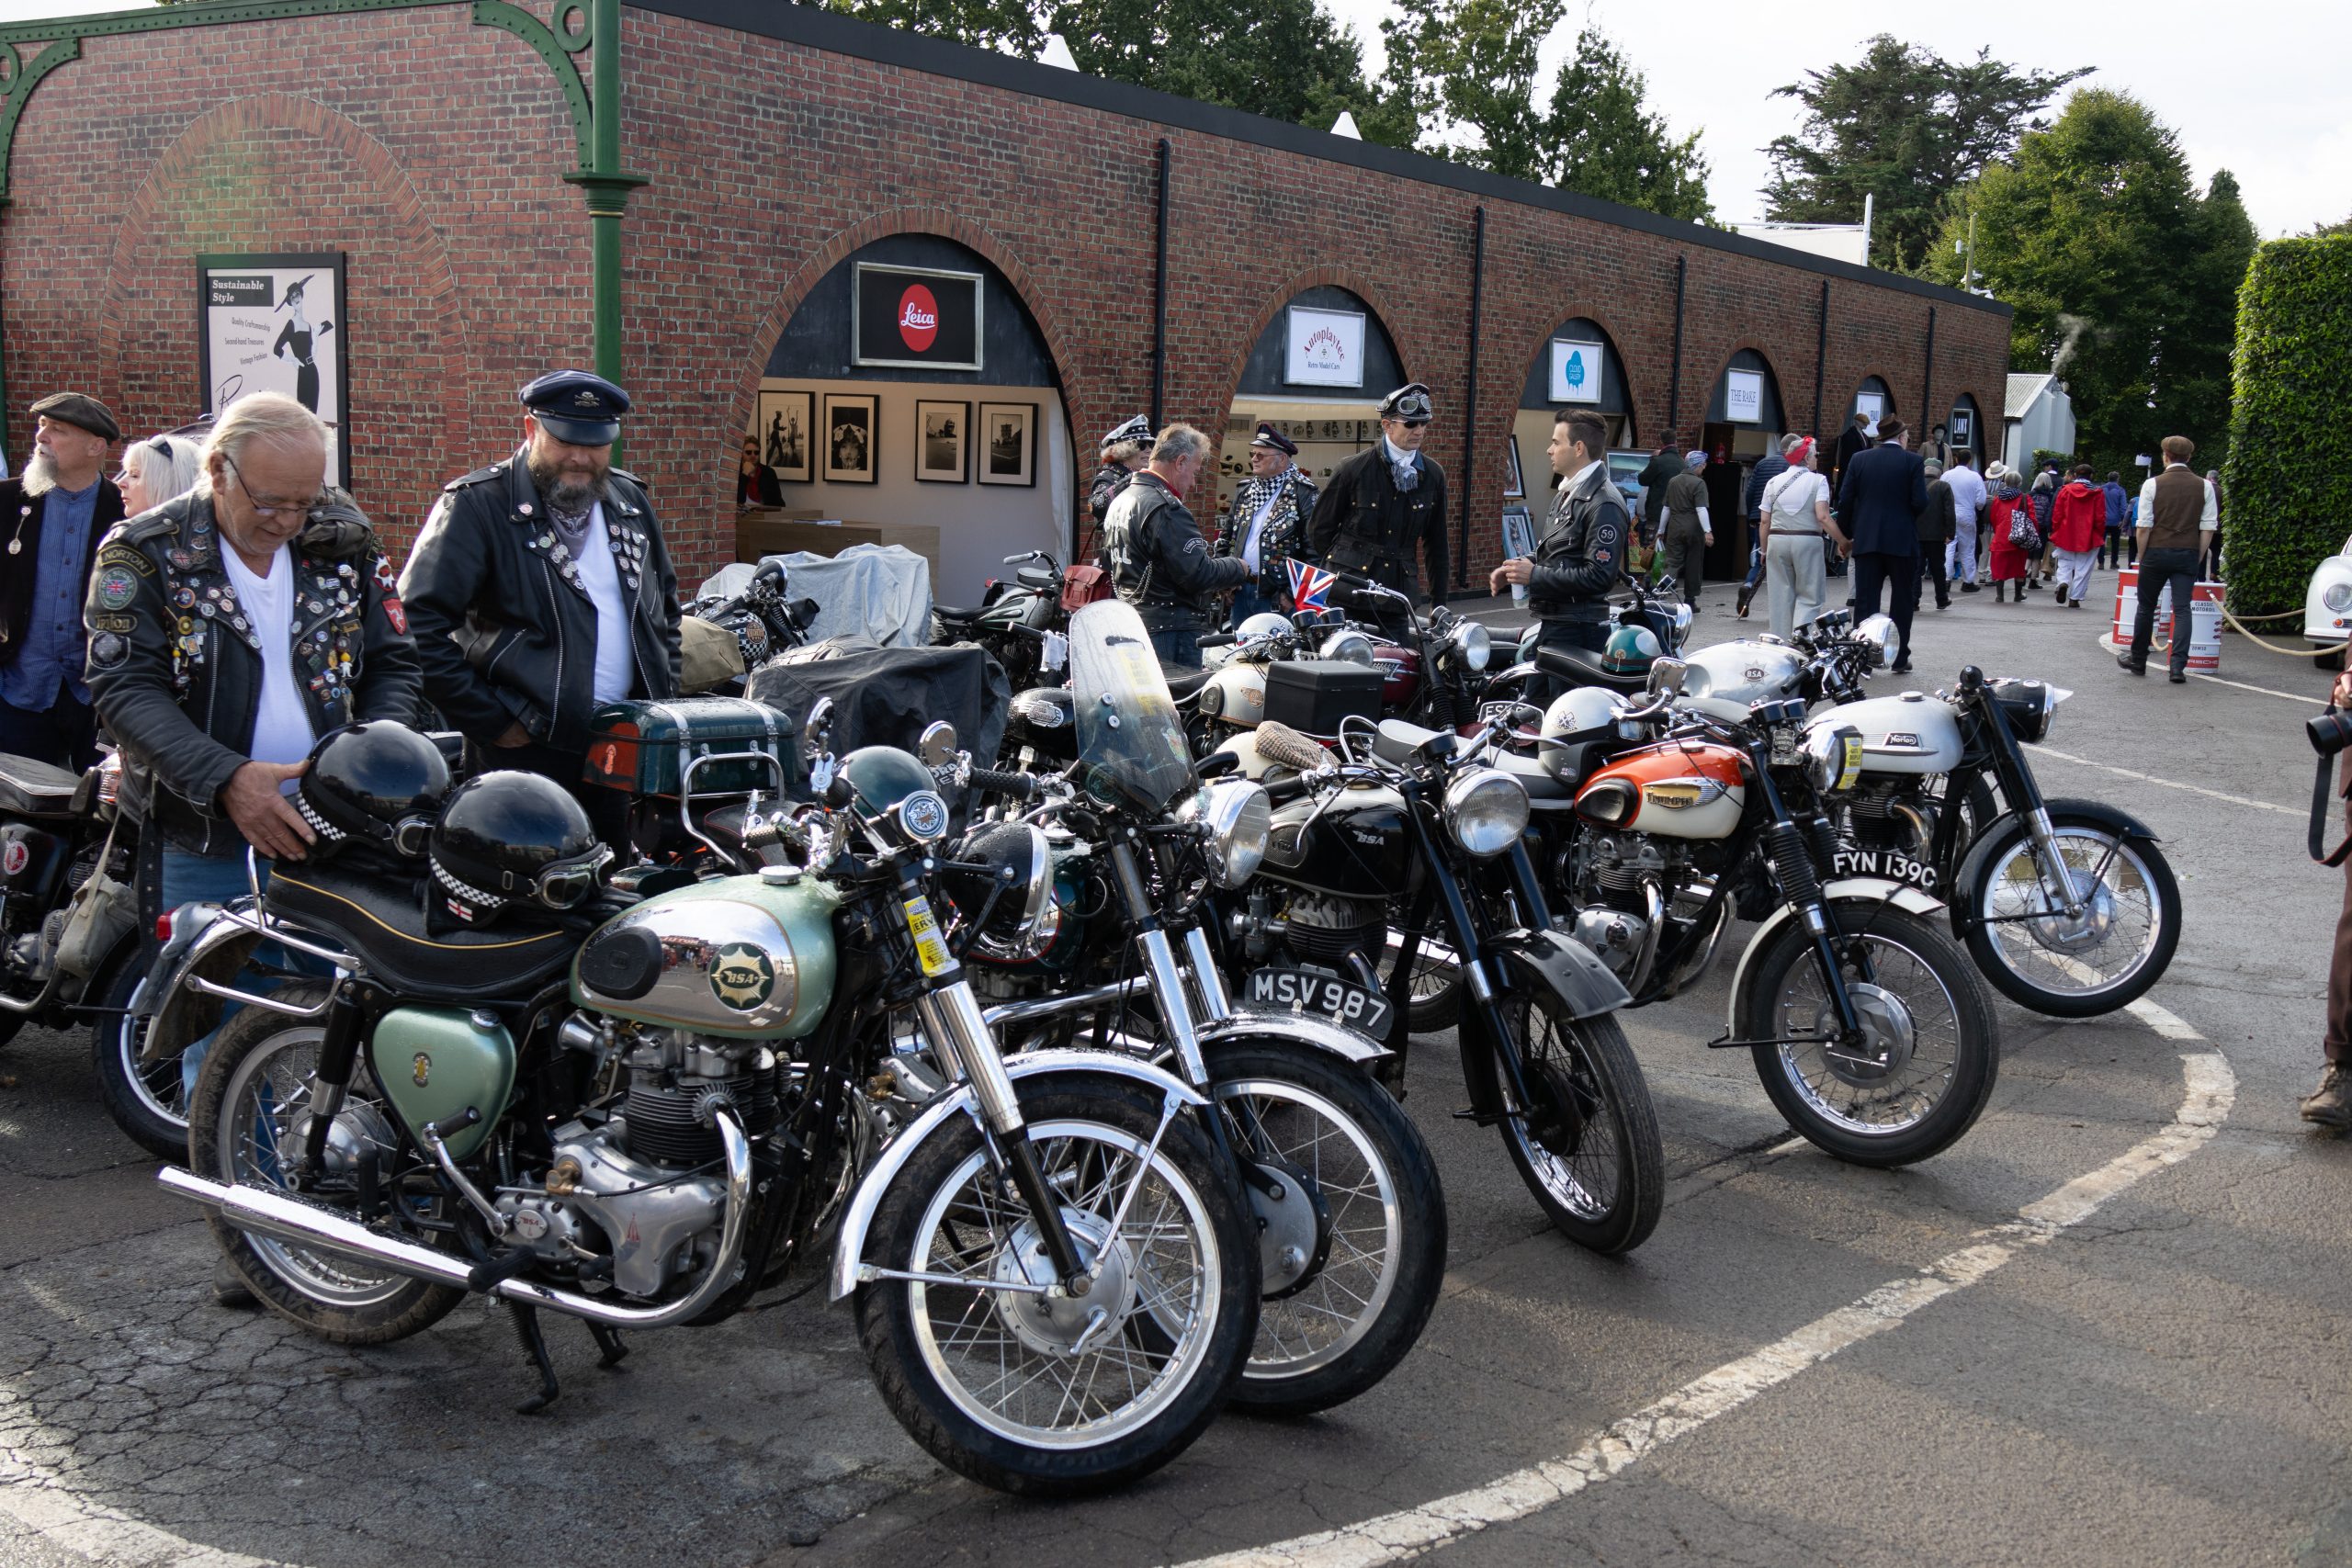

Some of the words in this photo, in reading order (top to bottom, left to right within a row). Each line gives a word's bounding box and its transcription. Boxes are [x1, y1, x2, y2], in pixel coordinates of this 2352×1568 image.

[212, 279, 265, 290] Sustainable
[212, 292, 235, 305] Style
[900, 301, 935, 330] Leica
[232, 316, 244, 328] Quality
[244, 319, 271, 333] Craftsmanship
[224, 337, 247, 345] Second-hand
[247, 337, 265, 346] Treasures
[240, 357, 254, 366] Vintage
[253, 352, 268, 362] Fashion
[1730, 389, 1742, 402] THE
[1742, 389, 1757, 403] RAKE
[1953, 417, 1968, 434] LANX
[1600, 529, 1614, 539] 59
[104, 549, 148, 570] NORTON
[1747, 670, 1762, 678] BSA
[1889, 734, 1917, 745] Norton
[1646, 793, 1694, 806] TRIUMPH
[1351, 829, 1385, 846] BSA
[1832, 851, 1877, 874] FYN
[1884, 854, 1937, 887] 139C
[722, 970, 754, 984] BSA
[1254, 974, 1319, 1004] MSV
[1322, 983, 1387, 1028] 987
[519, 1215, 539, 1226] BSA
